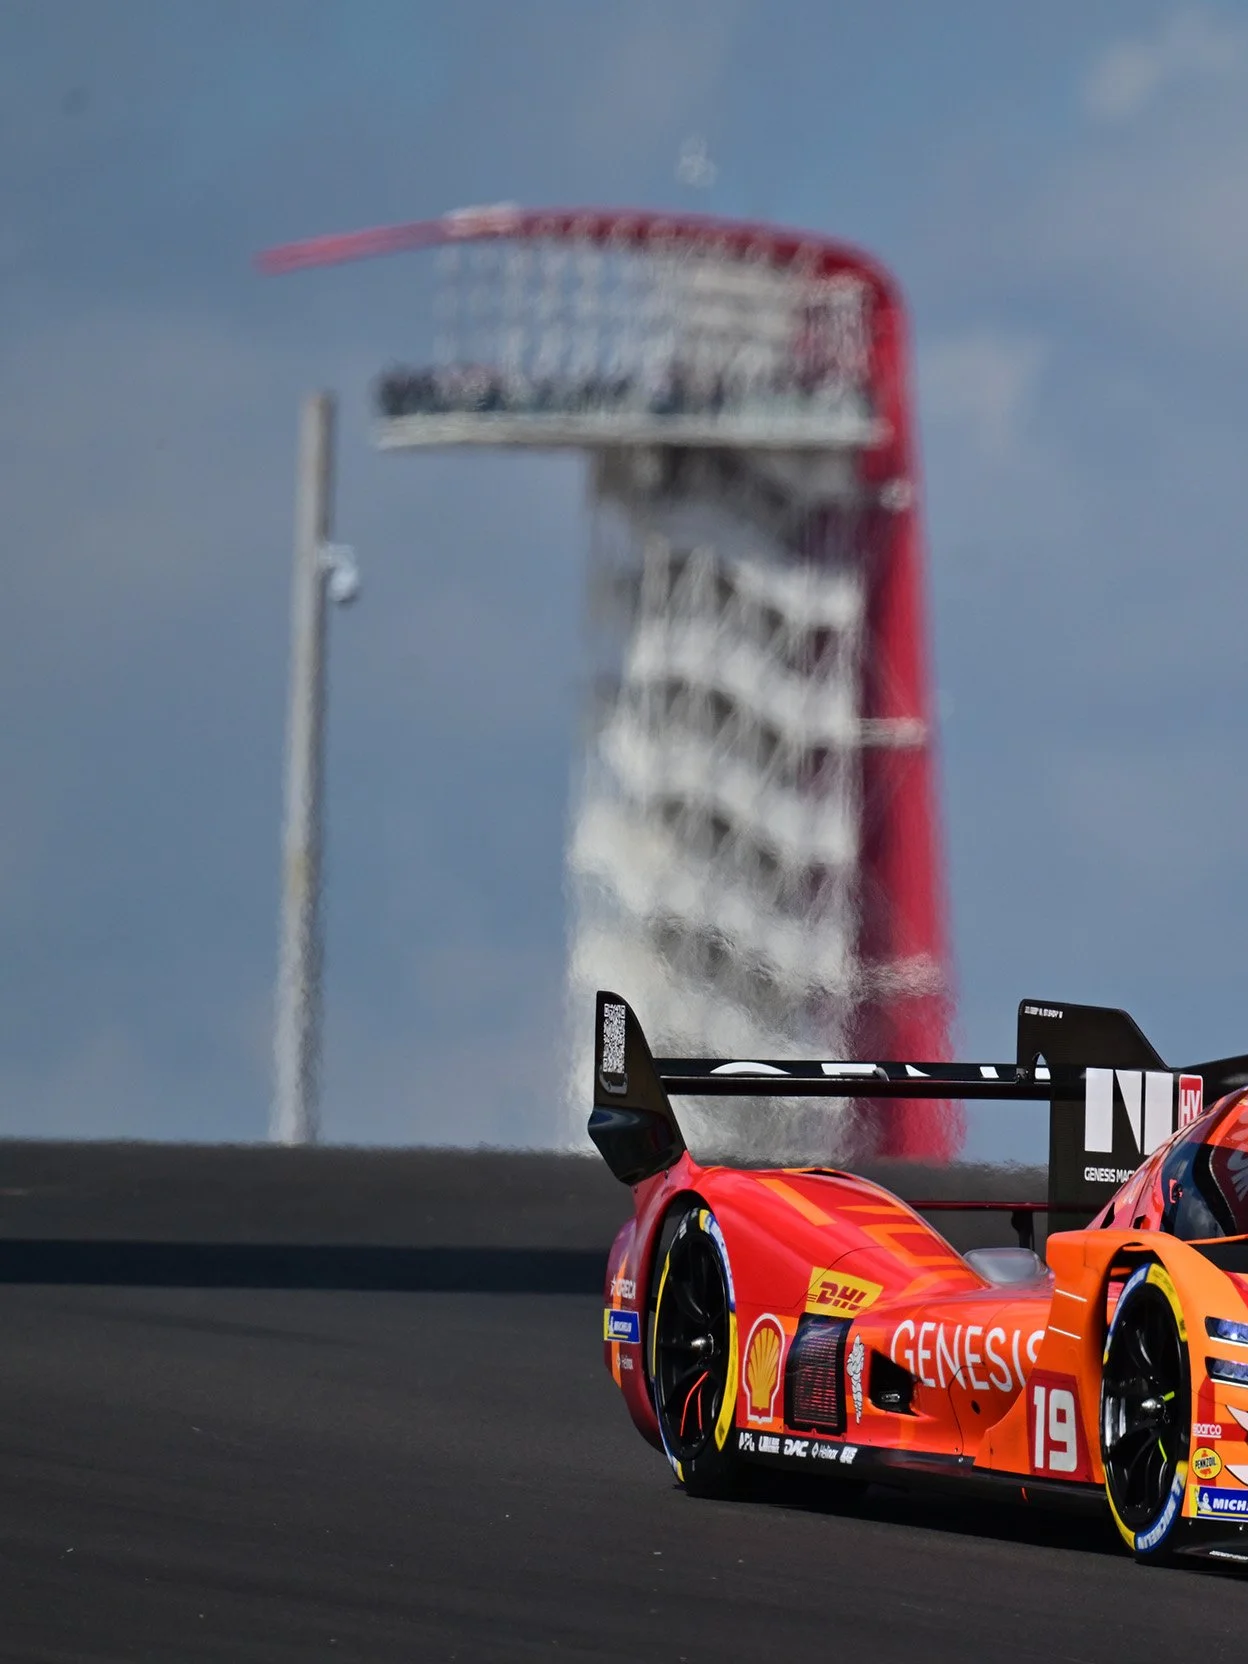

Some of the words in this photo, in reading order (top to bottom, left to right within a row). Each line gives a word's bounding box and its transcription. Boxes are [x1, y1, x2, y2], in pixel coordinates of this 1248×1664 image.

[1180, 1088, 1201, 1127] HY
[1084, 1166, 1115, 1182] GENESIS
[815, 1280, 868, 1311] DHL
[1033, 1385, 1078, 1473] 19
[1195, 1456, 1217, 1470] PENNZOIL
